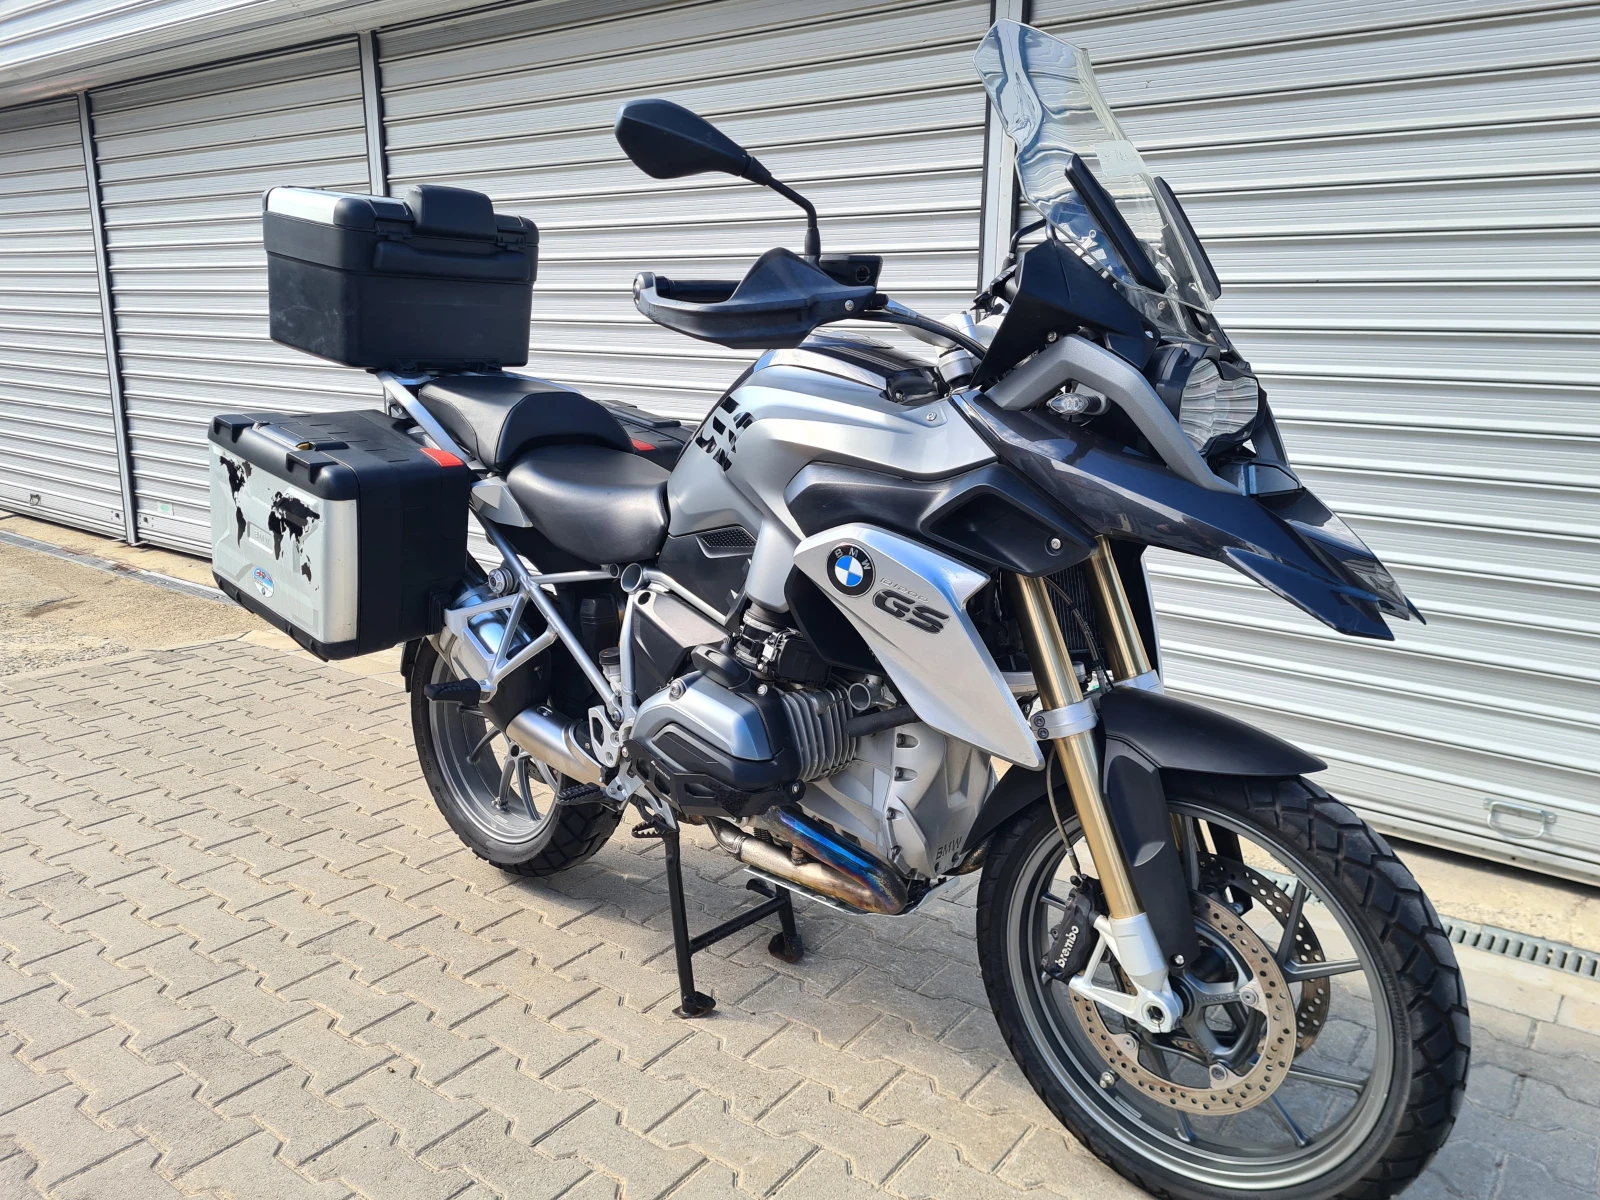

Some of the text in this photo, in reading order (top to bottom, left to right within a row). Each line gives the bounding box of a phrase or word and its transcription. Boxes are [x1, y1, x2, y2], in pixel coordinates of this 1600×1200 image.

[834, 547, 872, 570] BMW
[873, 588, 951, 635] GS
[935, 836, 963, 861] BMW
[1054, 925, 1080, 969] brembo
